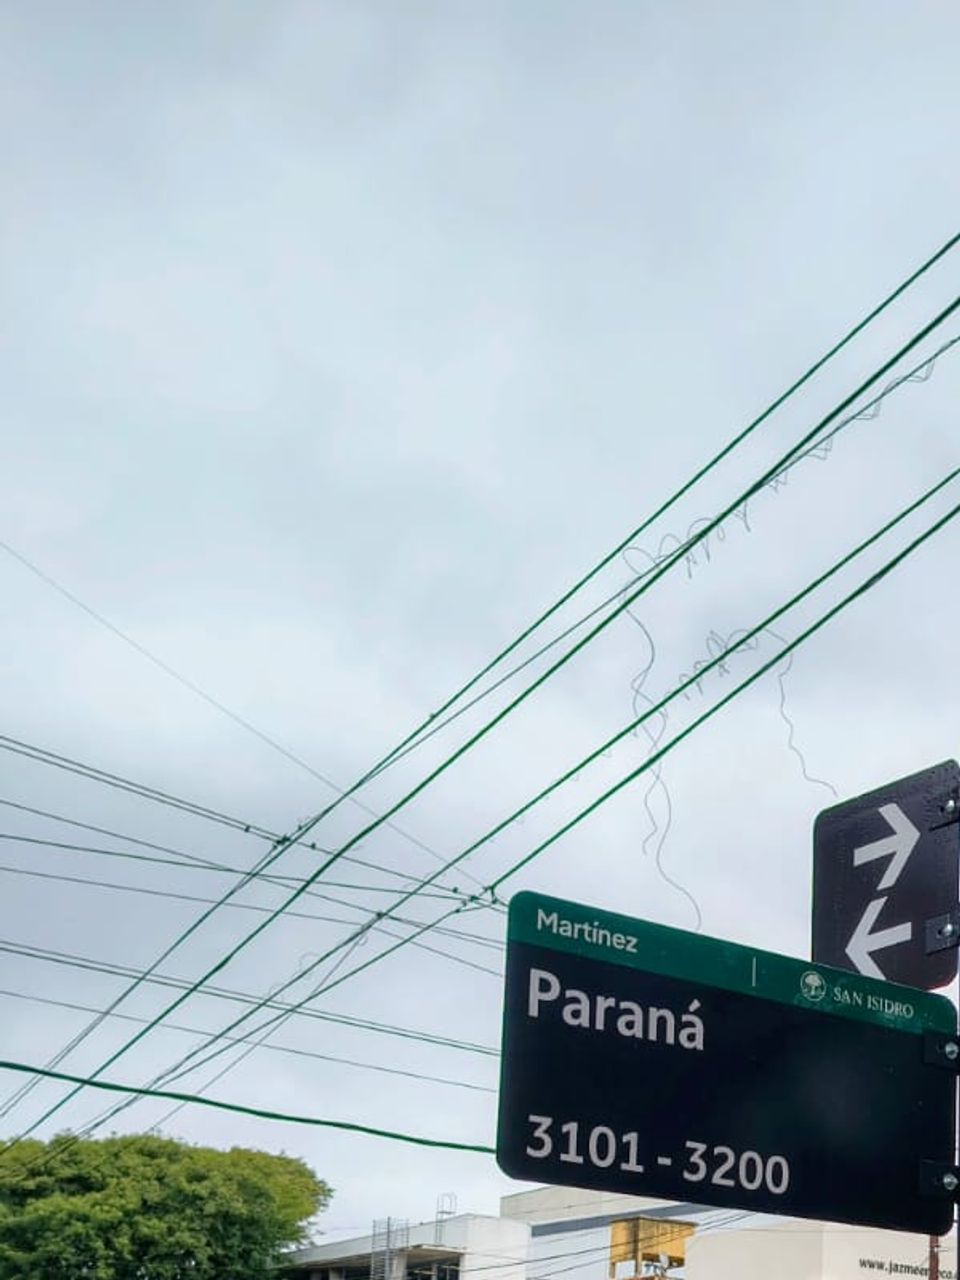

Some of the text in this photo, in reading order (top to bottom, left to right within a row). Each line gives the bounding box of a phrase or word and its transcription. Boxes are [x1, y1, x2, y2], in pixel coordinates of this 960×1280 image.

[537, 908, 639, 954] Martínez
[527, 968, 705, 1051] Paraná
[833, 986, 915, 1020] SAN ISIDRO
[525, 1114, 645, 1174] 3101
[682, 1141, 790, 1195] 3200
